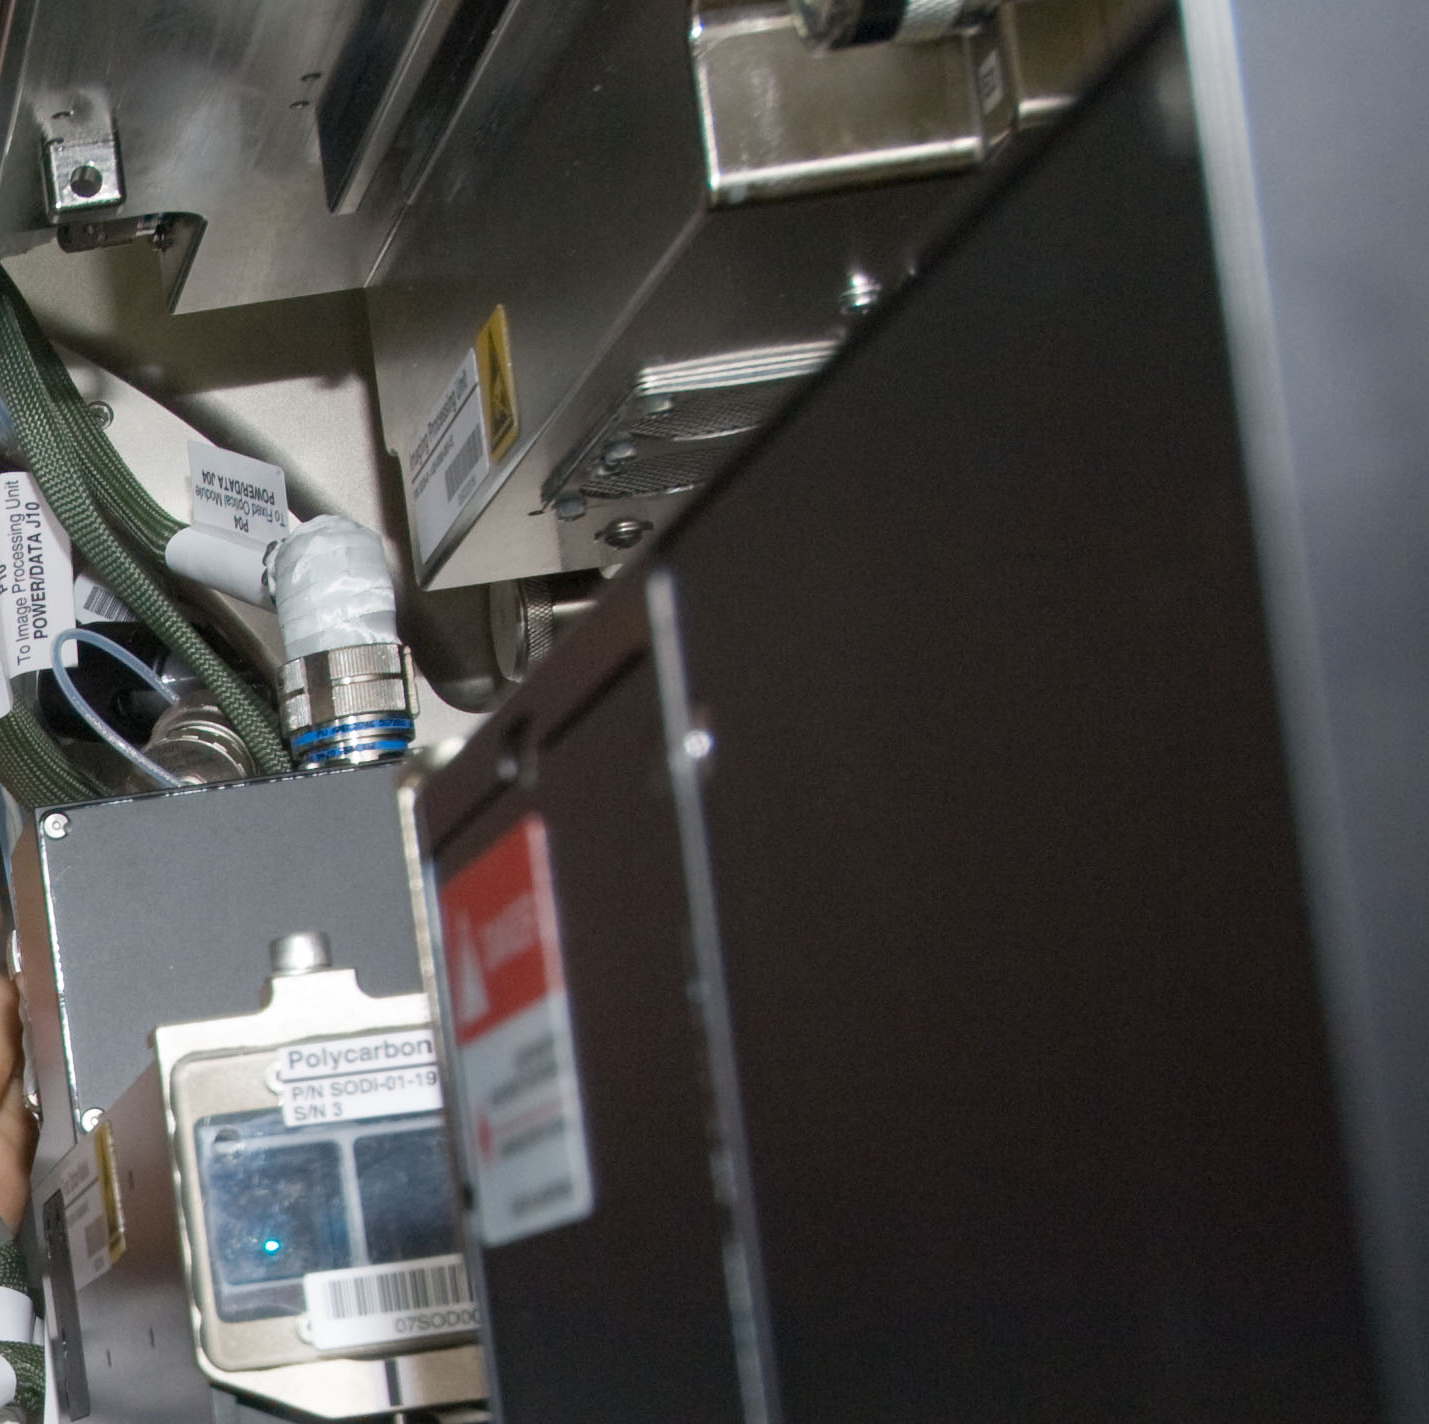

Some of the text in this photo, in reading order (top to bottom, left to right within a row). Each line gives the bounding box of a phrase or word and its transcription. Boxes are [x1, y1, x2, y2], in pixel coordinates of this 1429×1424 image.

[201, 469, 276, 506] POWER/DATA J04
[224, 494, 251, 516] Optical
[251, 502, 274, 523] Fixed
[233, 514, 249, 533] P04
[274, 510, 286, 528] To
[4, 479, 32, 667] To Image Processing Unit
[24, 502, 49, 641] POWER/DATA J10
[291, 1084, 325, 1102] P/N
[293, 1101, 345, 1122] S/N 3
